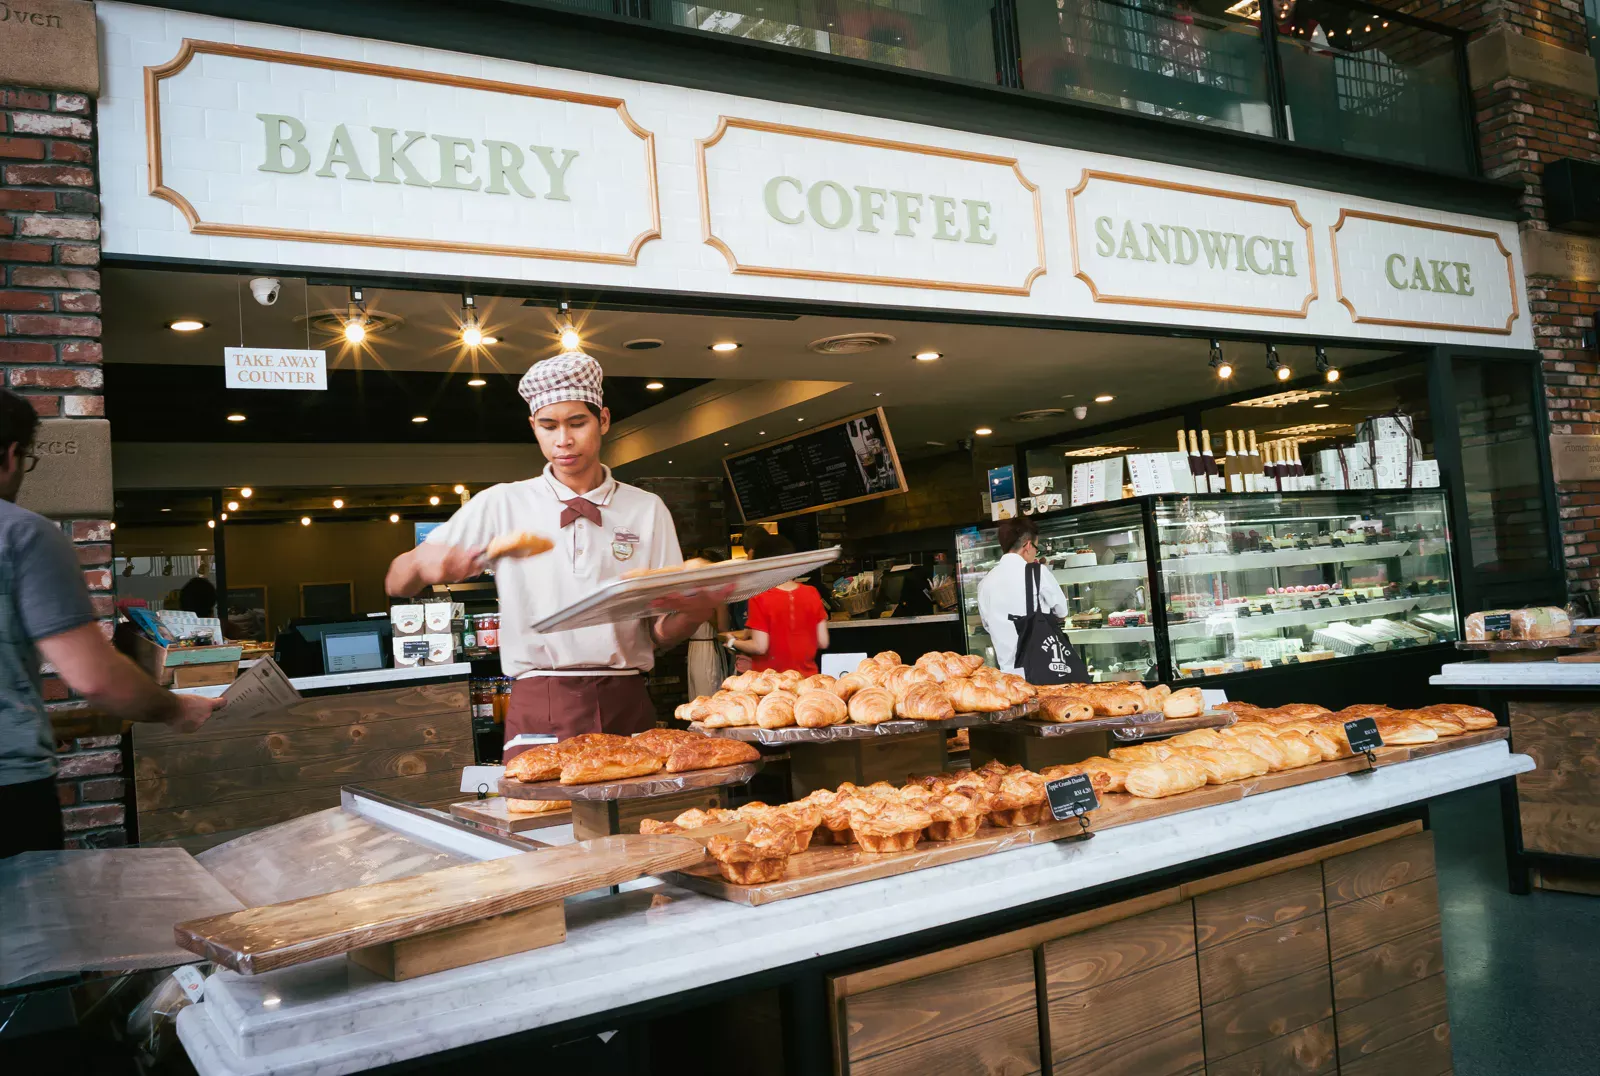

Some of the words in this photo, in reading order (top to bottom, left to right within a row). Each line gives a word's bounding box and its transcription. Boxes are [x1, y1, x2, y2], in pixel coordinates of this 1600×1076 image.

[256, 112, 580, 202] BAKERY
[764, 175, 997, 245] COFFEE
[1095, 216, 1298, 278] SANDWICH
[1385, 253, 1475, 296] CAKE
[233, 354, 274, 367] TAKE
[278, 355, 319, 368] AWAY
[237, 370, 316, 384] COUNTER
